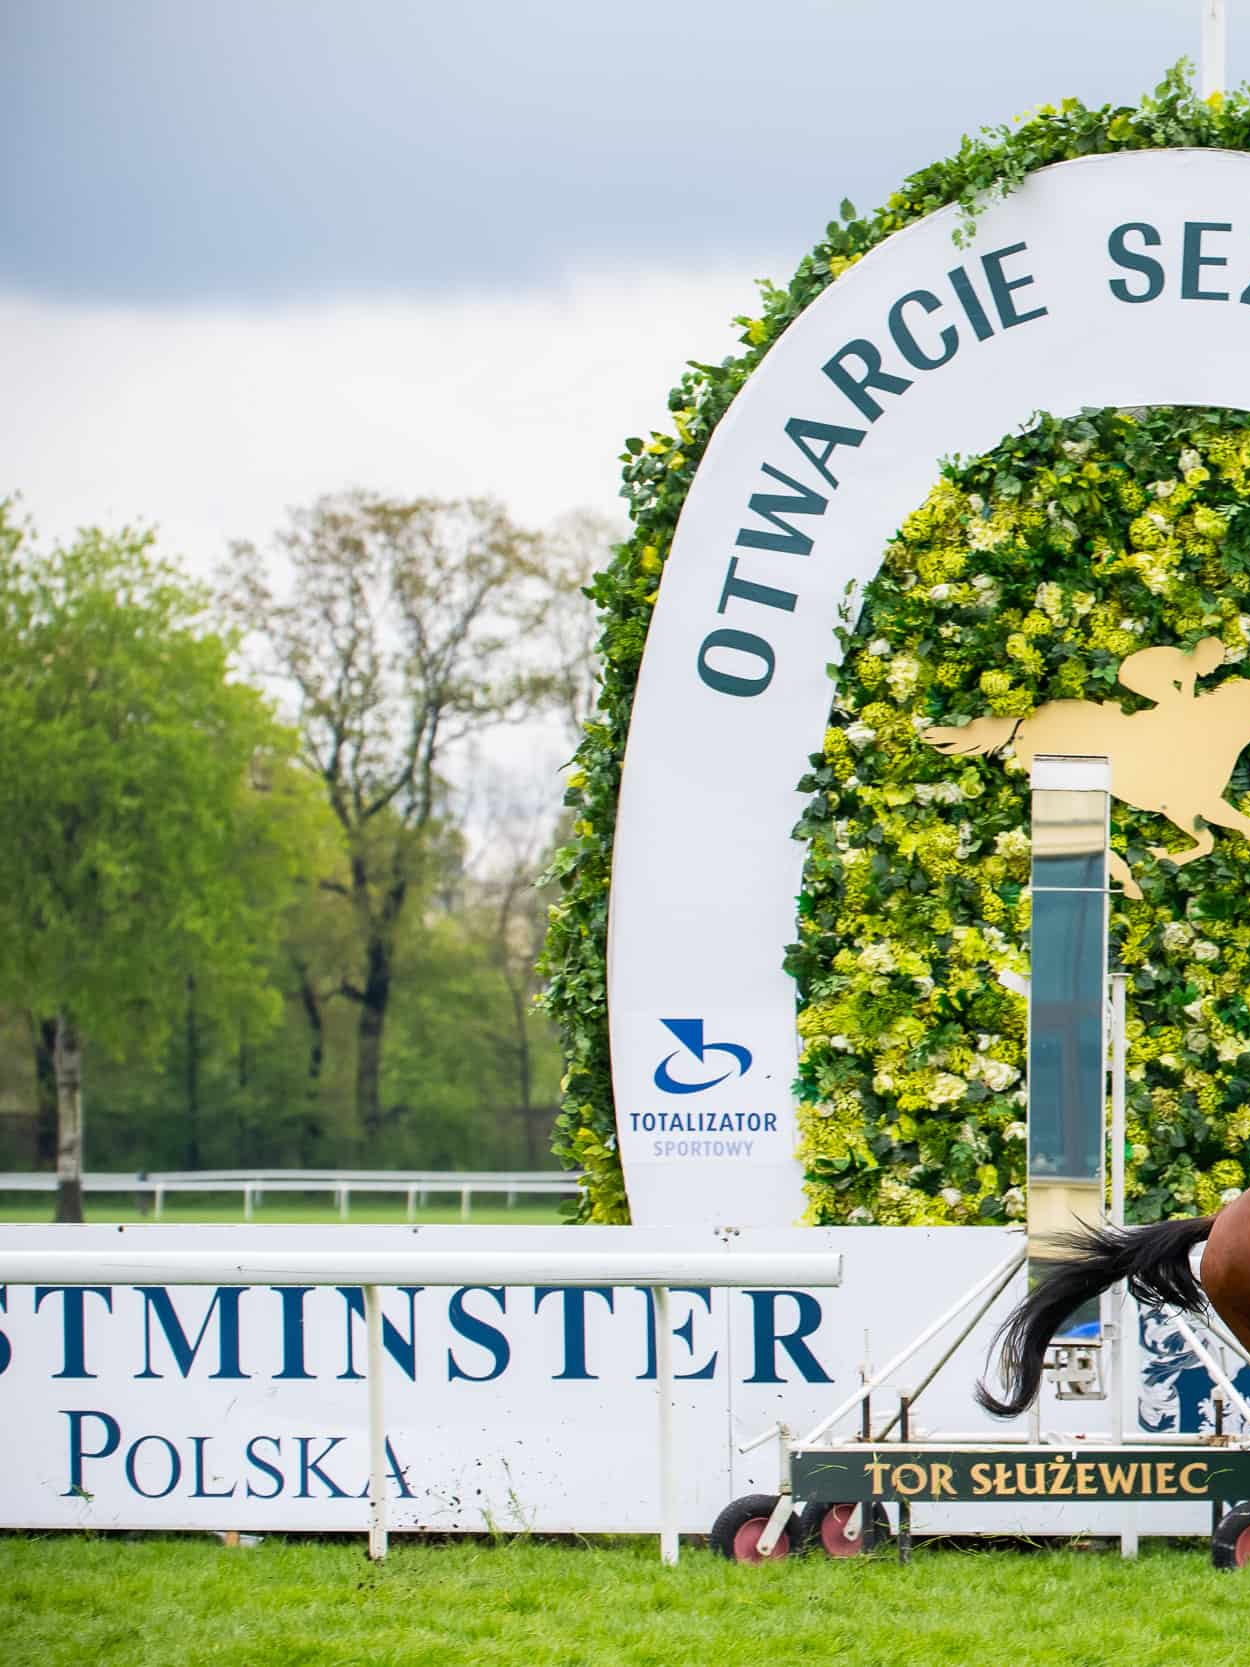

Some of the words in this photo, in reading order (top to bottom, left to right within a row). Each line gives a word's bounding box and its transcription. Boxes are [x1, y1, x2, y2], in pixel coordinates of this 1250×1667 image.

[697, 241, 1049, 698] OTWARCIE
[629, 1112, 777, 1133] TOTALIZATOR
[652, 1139, 754, 1157] SPORTOWY
[0, 1285, 835, 1385] TMINSTER
[57, 1409, 419, 1499] POLSKA
[863, 1462, 957, 1495] TOR
[969, 1454, 1210, 1496] SŁUŻEWIEC
